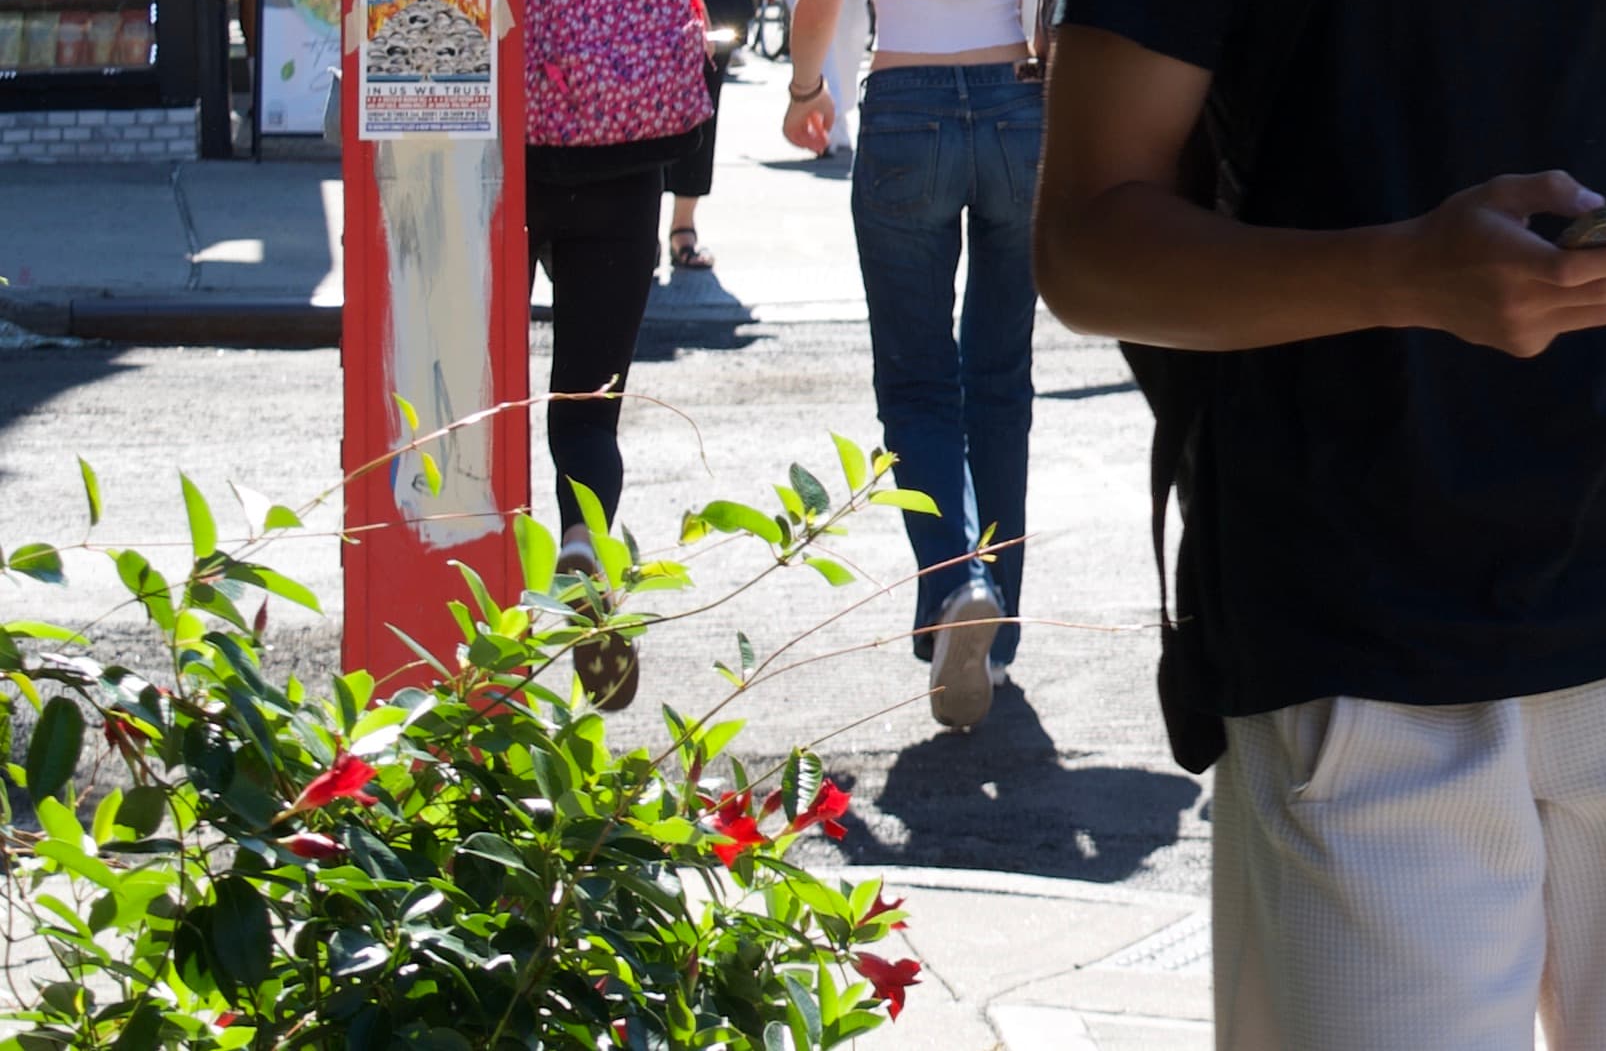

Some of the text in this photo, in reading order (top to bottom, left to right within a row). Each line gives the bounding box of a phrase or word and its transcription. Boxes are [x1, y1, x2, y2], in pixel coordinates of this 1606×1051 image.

[367, 86, 489, 95] IN US WE TRUST
